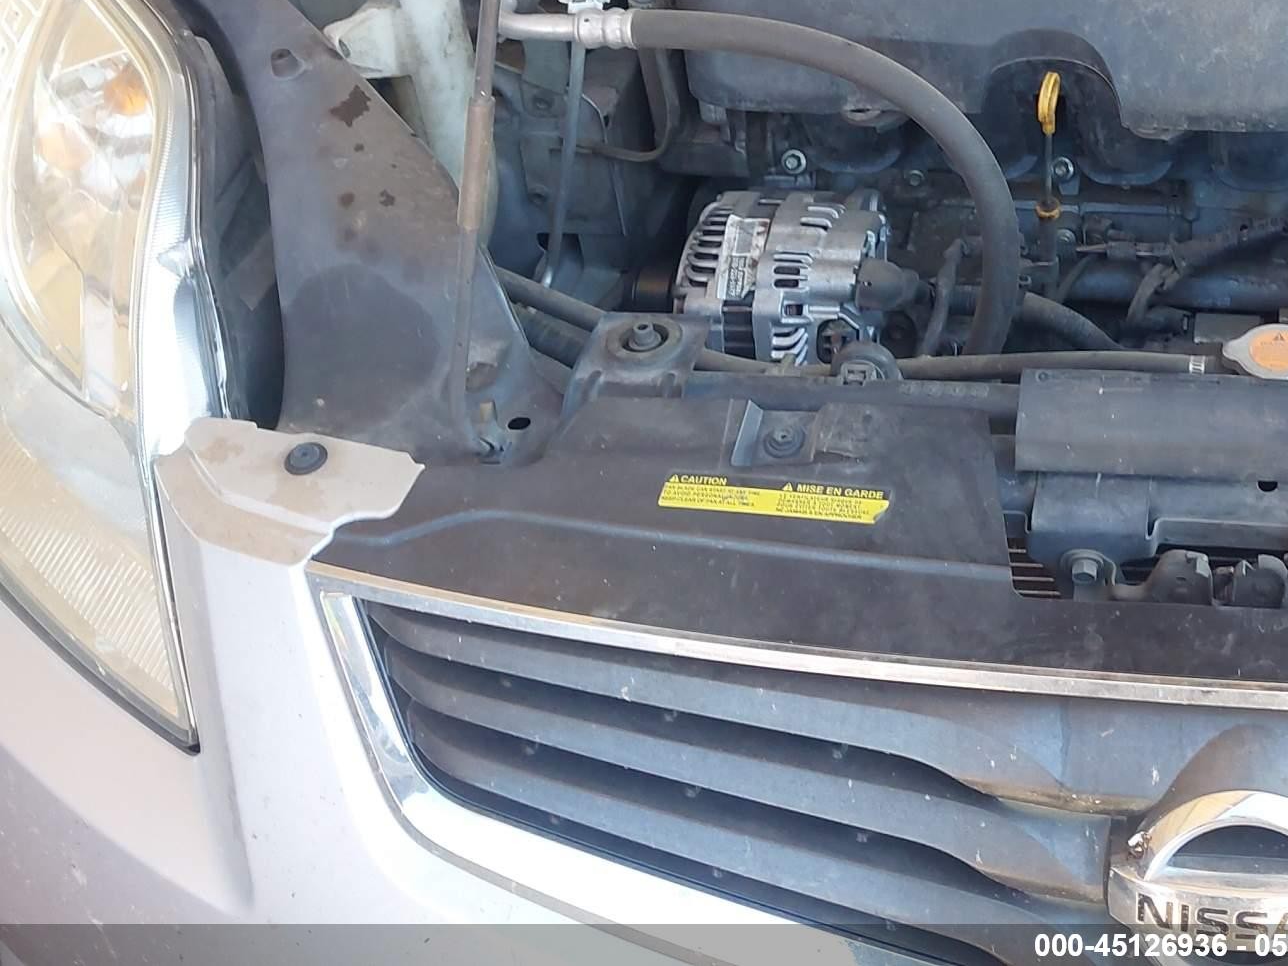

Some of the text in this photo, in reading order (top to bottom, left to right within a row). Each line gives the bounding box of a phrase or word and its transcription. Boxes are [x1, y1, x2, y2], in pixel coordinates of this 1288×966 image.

[680, 474, 728, 486] CAUTION
[796, 483, 884, 500] MISE EN GARDE
